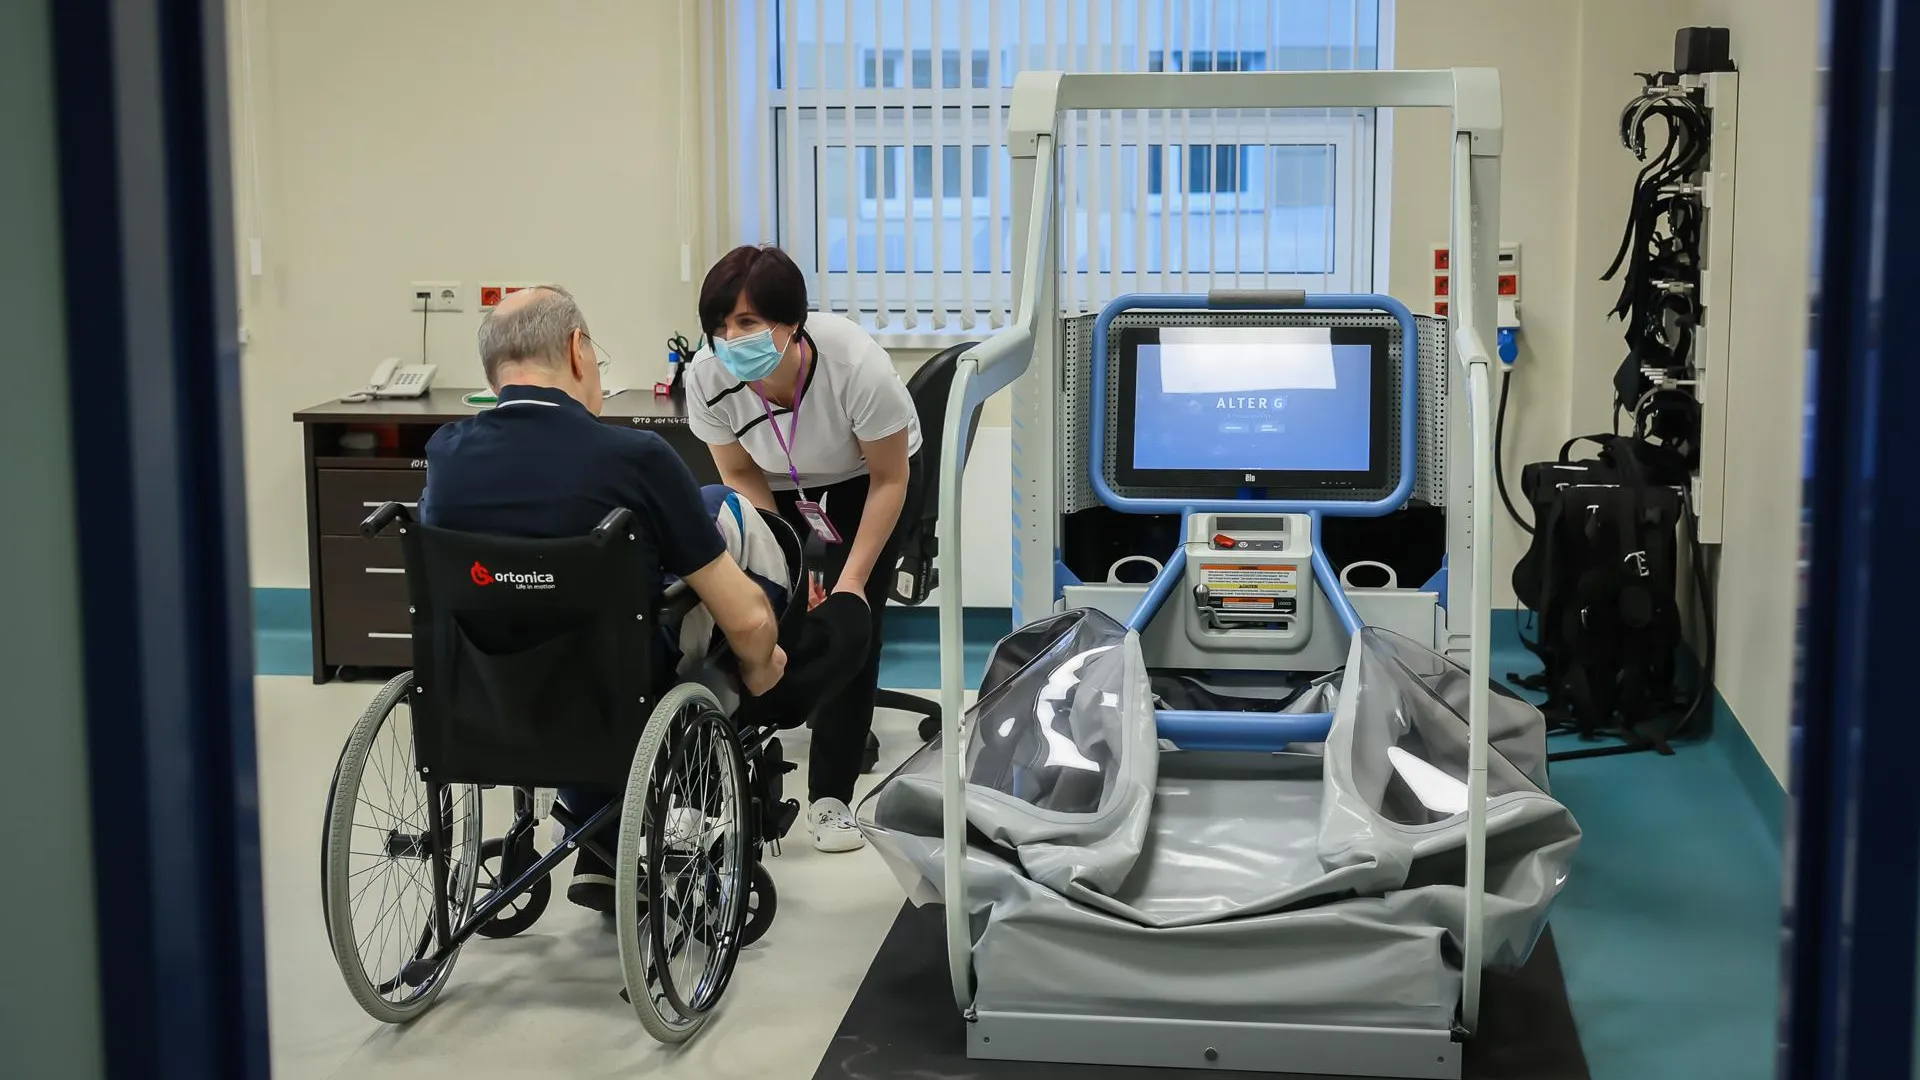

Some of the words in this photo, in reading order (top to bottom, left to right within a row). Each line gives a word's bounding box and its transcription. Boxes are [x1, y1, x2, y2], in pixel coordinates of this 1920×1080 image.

[1216, 397, 1268, 409] ALTER
[1273, 397, 1283, 409] G
[494, 571, 554, 583] ortonica
